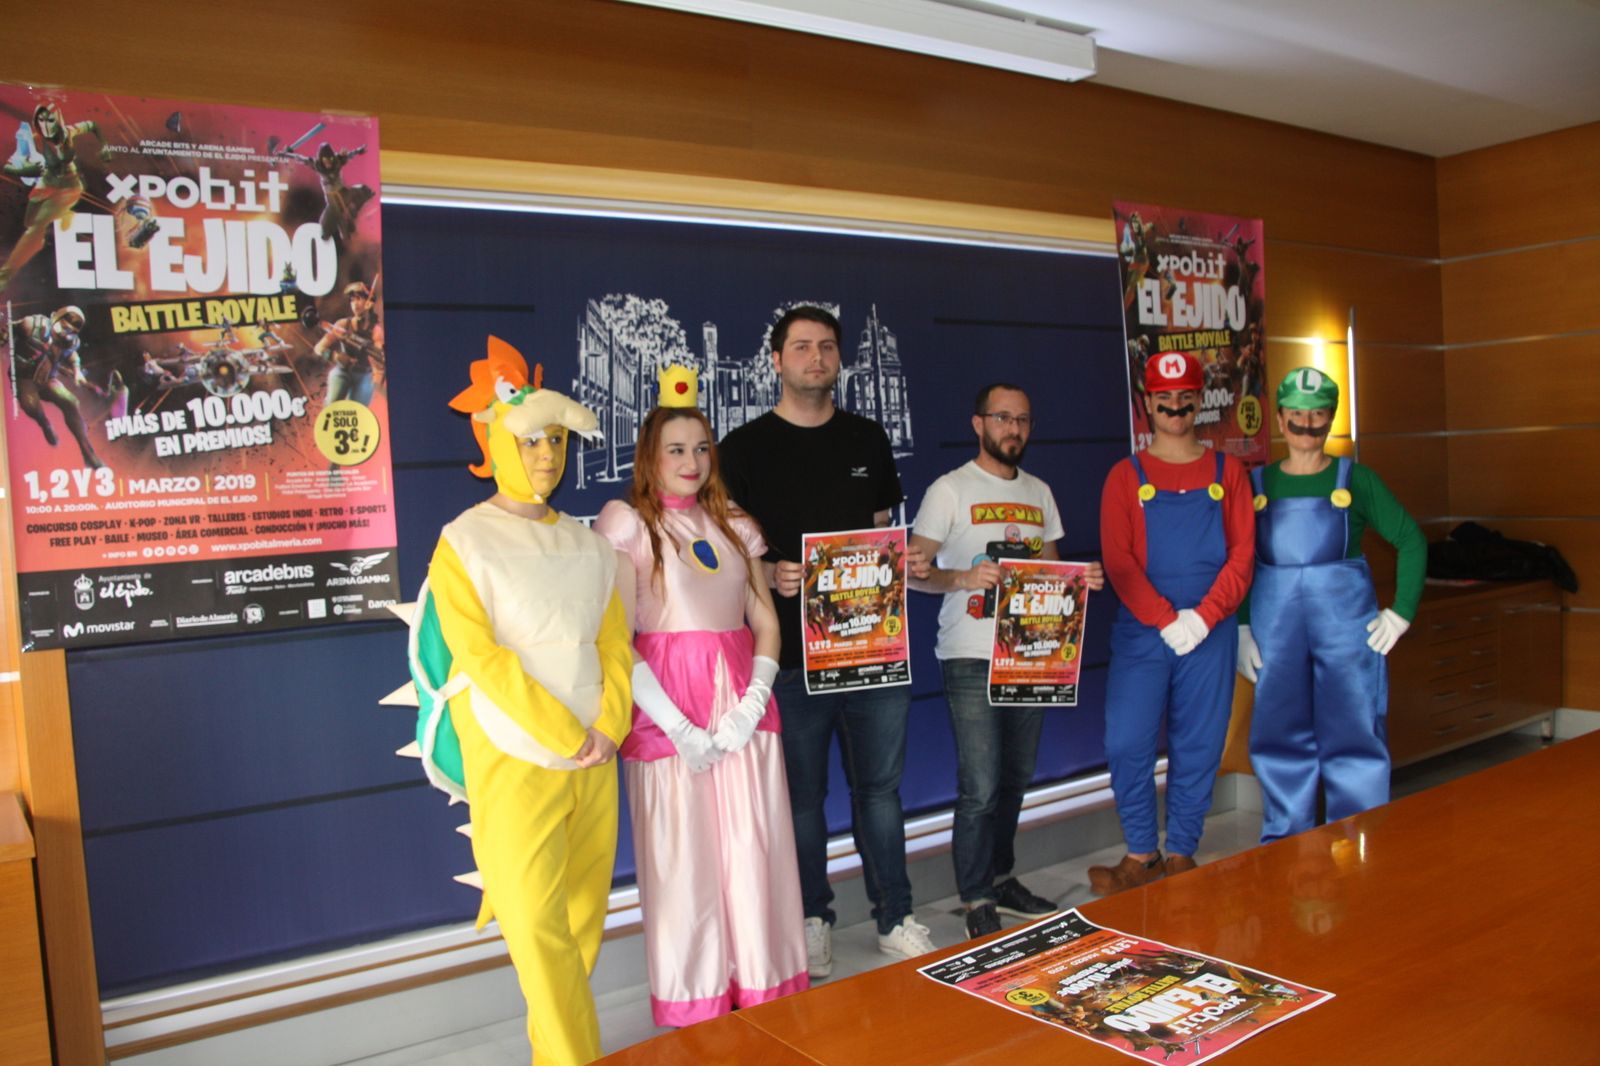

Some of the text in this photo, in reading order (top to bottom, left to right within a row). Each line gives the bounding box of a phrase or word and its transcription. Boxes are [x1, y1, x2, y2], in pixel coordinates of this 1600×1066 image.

[105, 166, 289, 213] xpobit
[53, 213, 338, 296] EL EJIDO
[1157, 250, 1226, 279] xpobit
[111, 295, 298, 333] BATTLE ROYALE
[1137, 278, 1246, 331] EL EJIDO
[1158, 330, 1231, 351] BATTLE ROYALE
[1164, 359, 1181, 374] M
[1302, 370, 1315, 390] L
[105, 409, 160, 441] ¡MÁS
[161, 410, 188, 432] DE
[333, 416, 359, 428] SOLO
[155, 422, 272, 457] EN PREMIOS!
[128, 476, 201, 495] MARZO
[214, 474, 256, 491] 2019
[25, 505, 52, 514] 10:00
[54, 504, 62, 513] A
[105, 500, 156, 510] AUDITORIO
[157, 497, 206, 508] MUNICIPAL
[207, 495, 220, 505] DE
[220, 495, 231, 504] EL
[232, 494, 258, 504] EJIDO
[26, 504, 387, 534] CONCURSO COSPLAY K-POP ZONA VR TALLERES ESTUDIOS INDIE RETRO E-SPORTS
[50, 537, 71, 548] FREE
[73, 535, 97, 546] PLAY
[104, 533, 129, 545] BAILE
[136, 531, 168, 543] MUSEO
[175, 527, 198, 540] ÁREA
[200, 526, 248, 538] COMERCIAL
[255, 521, 307, 536] CONDUCCIÓN
[817, 569, 838, 592] EL
[1009, 593, 1027, 614] EL
[87, 621, 135, 634] movistar
